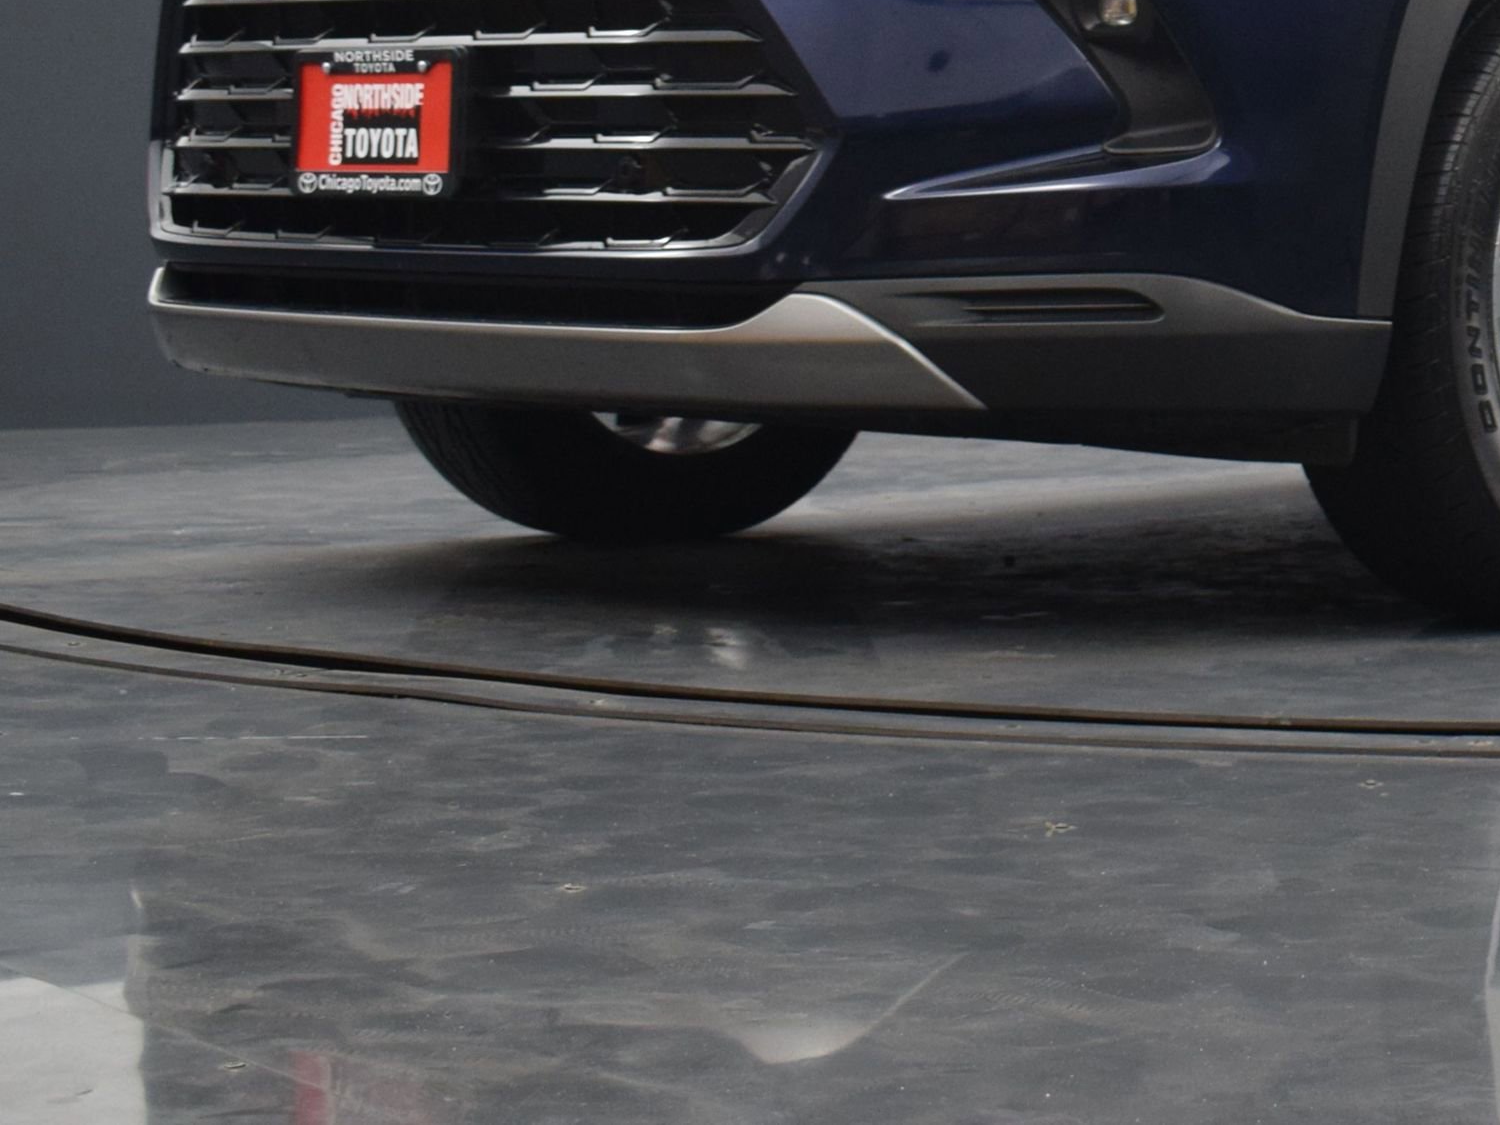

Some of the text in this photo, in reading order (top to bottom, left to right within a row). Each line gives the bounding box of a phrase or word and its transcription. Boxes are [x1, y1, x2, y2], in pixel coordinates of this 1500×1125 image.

[333, 49, 414, 63] NORTHSIDE
[354, 62, 396, 74] TOYOTA
[343, 83, 425, 110] NORTHSIDE
[328, 83, 345, 166] CHICAGO
[344, 127, 419, 159] TOYOTA
[318, 174, 422, 194] ChicagoToyota.com
